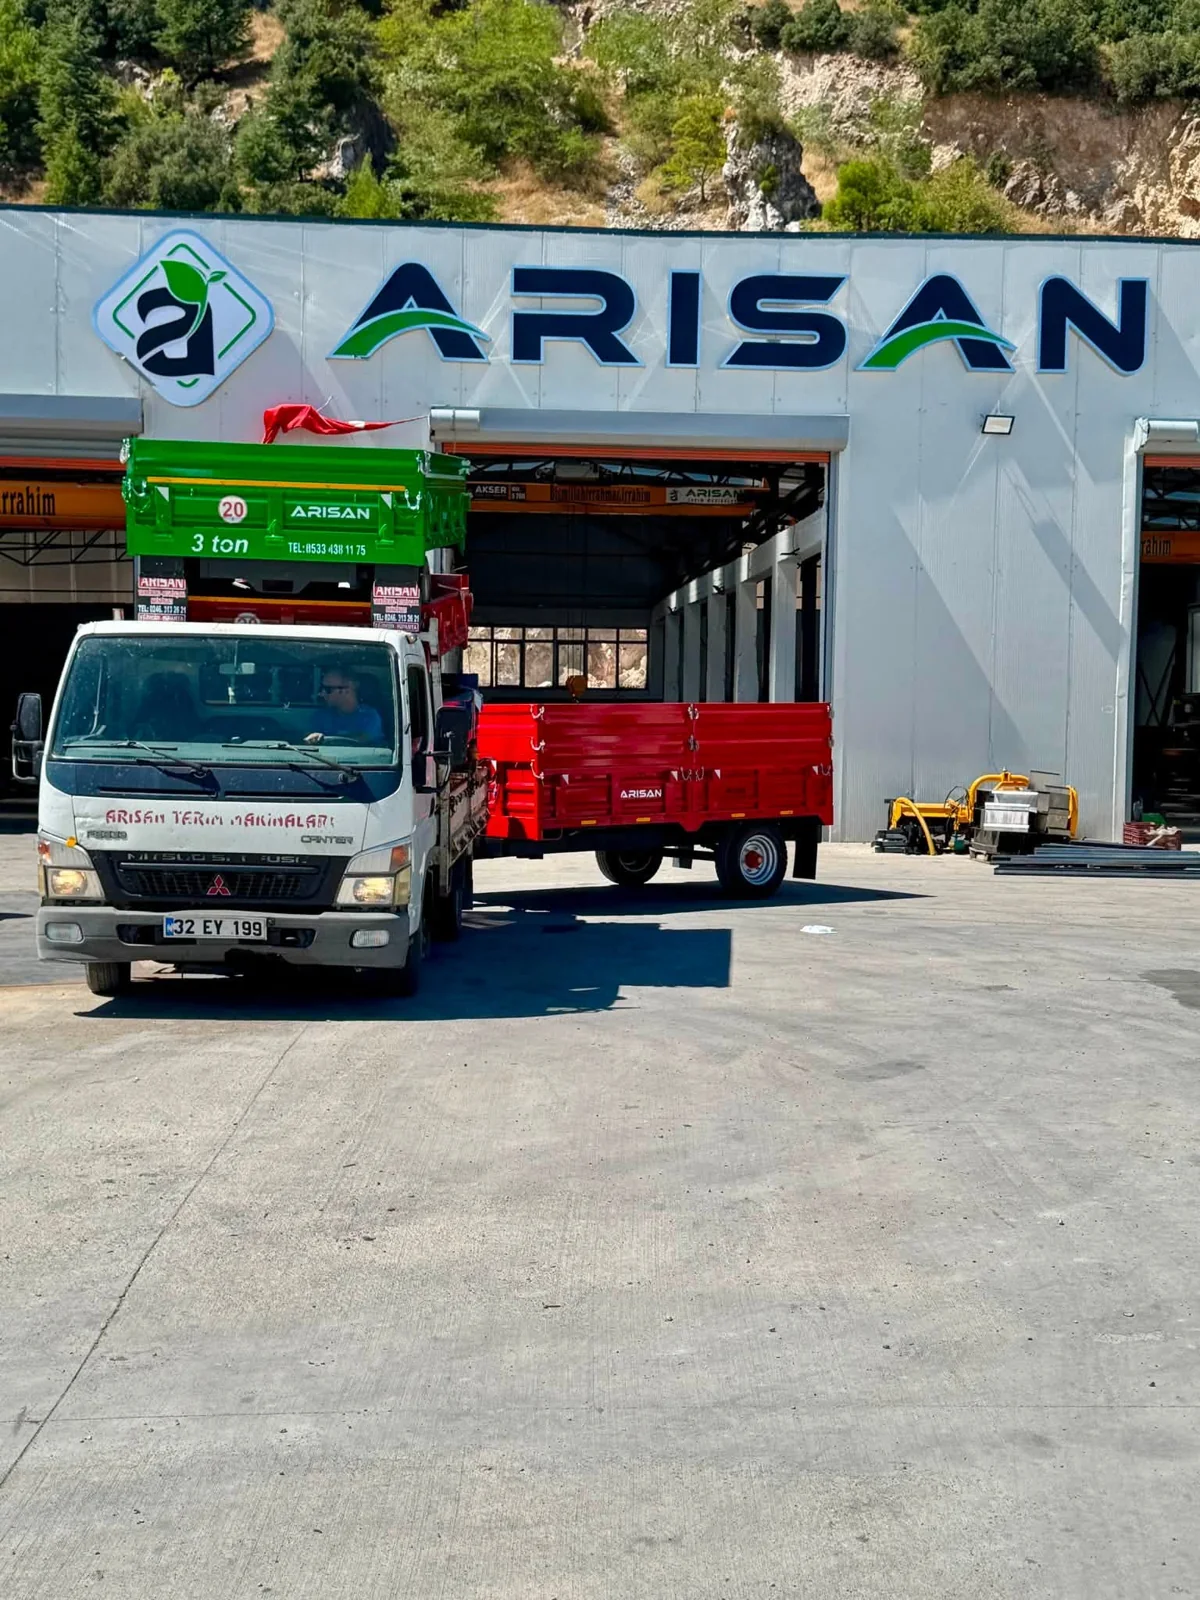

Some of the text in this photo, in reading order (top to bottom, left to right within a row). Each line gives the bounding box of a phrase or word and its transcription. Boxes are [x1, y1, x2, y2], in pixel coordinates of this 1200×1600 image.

[329, 262, 1147, 374] ARISAN
[475, 485, 507, 494] AKSER
[686, 489, 745, 497] ARISAN
[0, 486, 56, 516] rrahim
[222, 501, 244, 518] 20
[290, 505, 370, 520] ARISAN
[191, 533, 249, 554] 3 ton
[345, 545, 354, 555] 11
[356, 545, 366, 556] 75
[140, 577, 184, 588] ARISAN
[375, 586, 418, 596] ARISAN
[620, 789, 662, 798] ARISAN
[106, 809, 165, 825] ARISAN
[300, 835, 354, 845] CANTER
[174, 918, 262, 937] 32 EY 199
